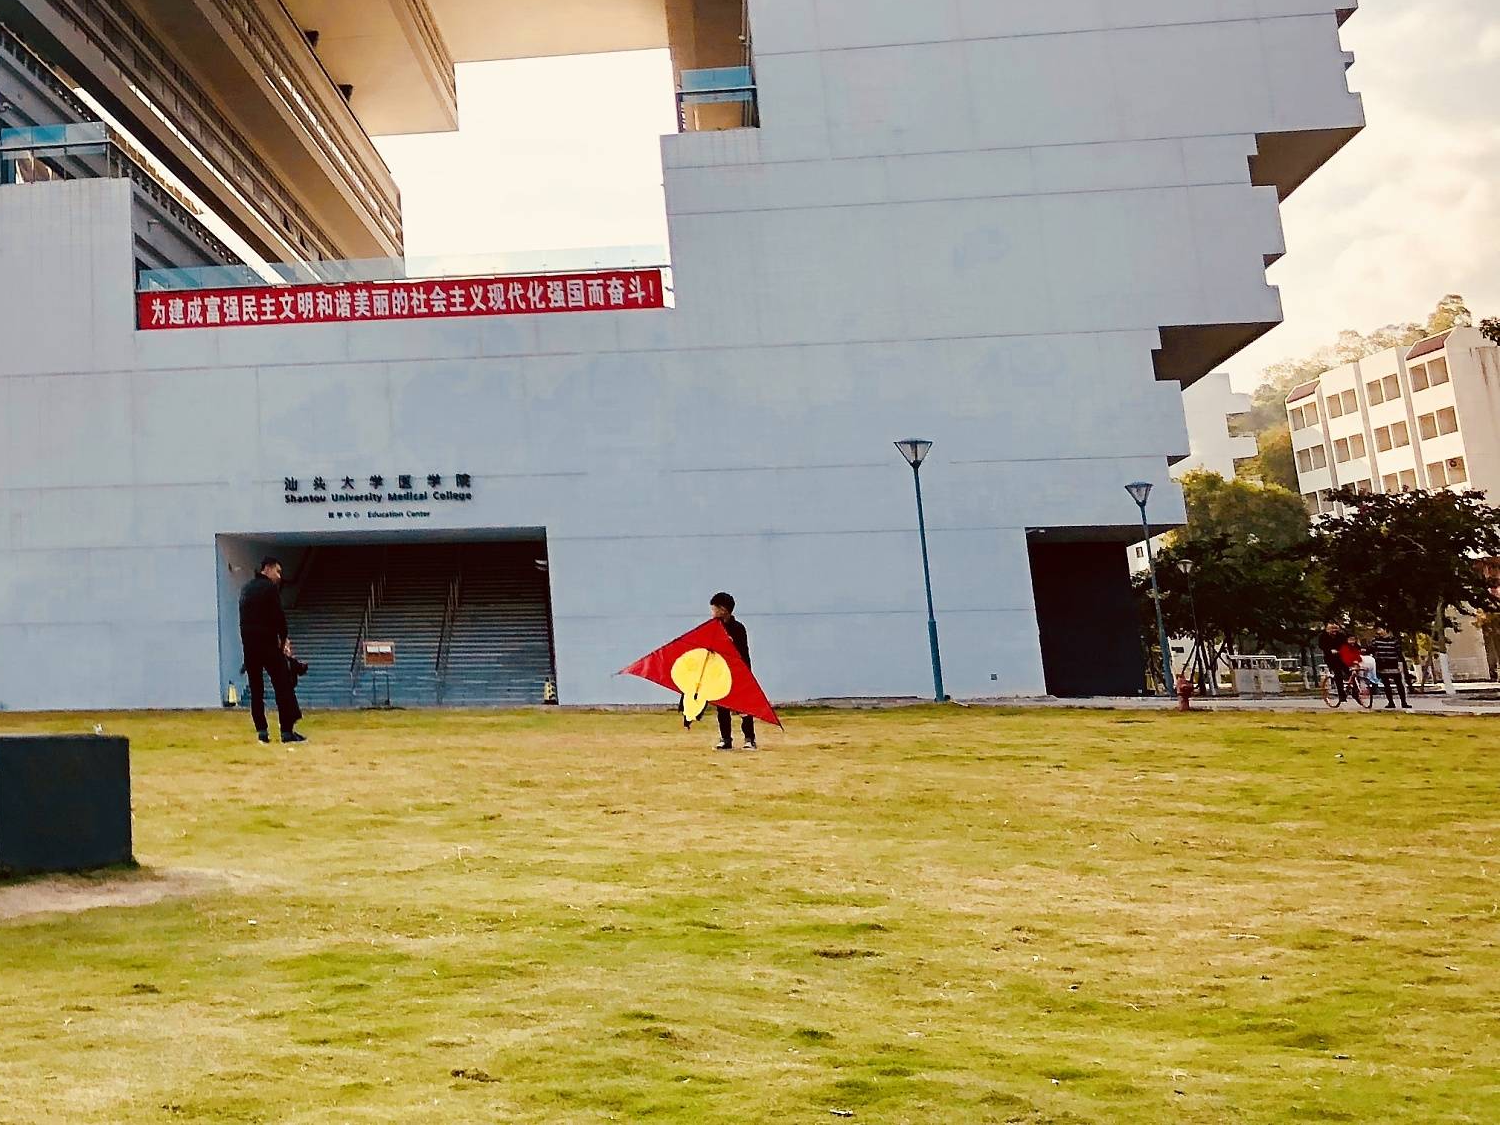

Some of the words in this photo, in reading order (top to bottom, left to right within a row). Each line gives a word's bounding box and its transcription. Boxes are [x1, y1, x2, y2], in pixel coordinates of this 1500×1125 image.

[284, 494, 326, 504] Shantou
[331, 492, 383, 503] University
[388, 491, 428, 502] Medical
[433, 490, 472, 502] College
[367, 510, 404, 519] Education
[406, 509, 431, 518] Center
